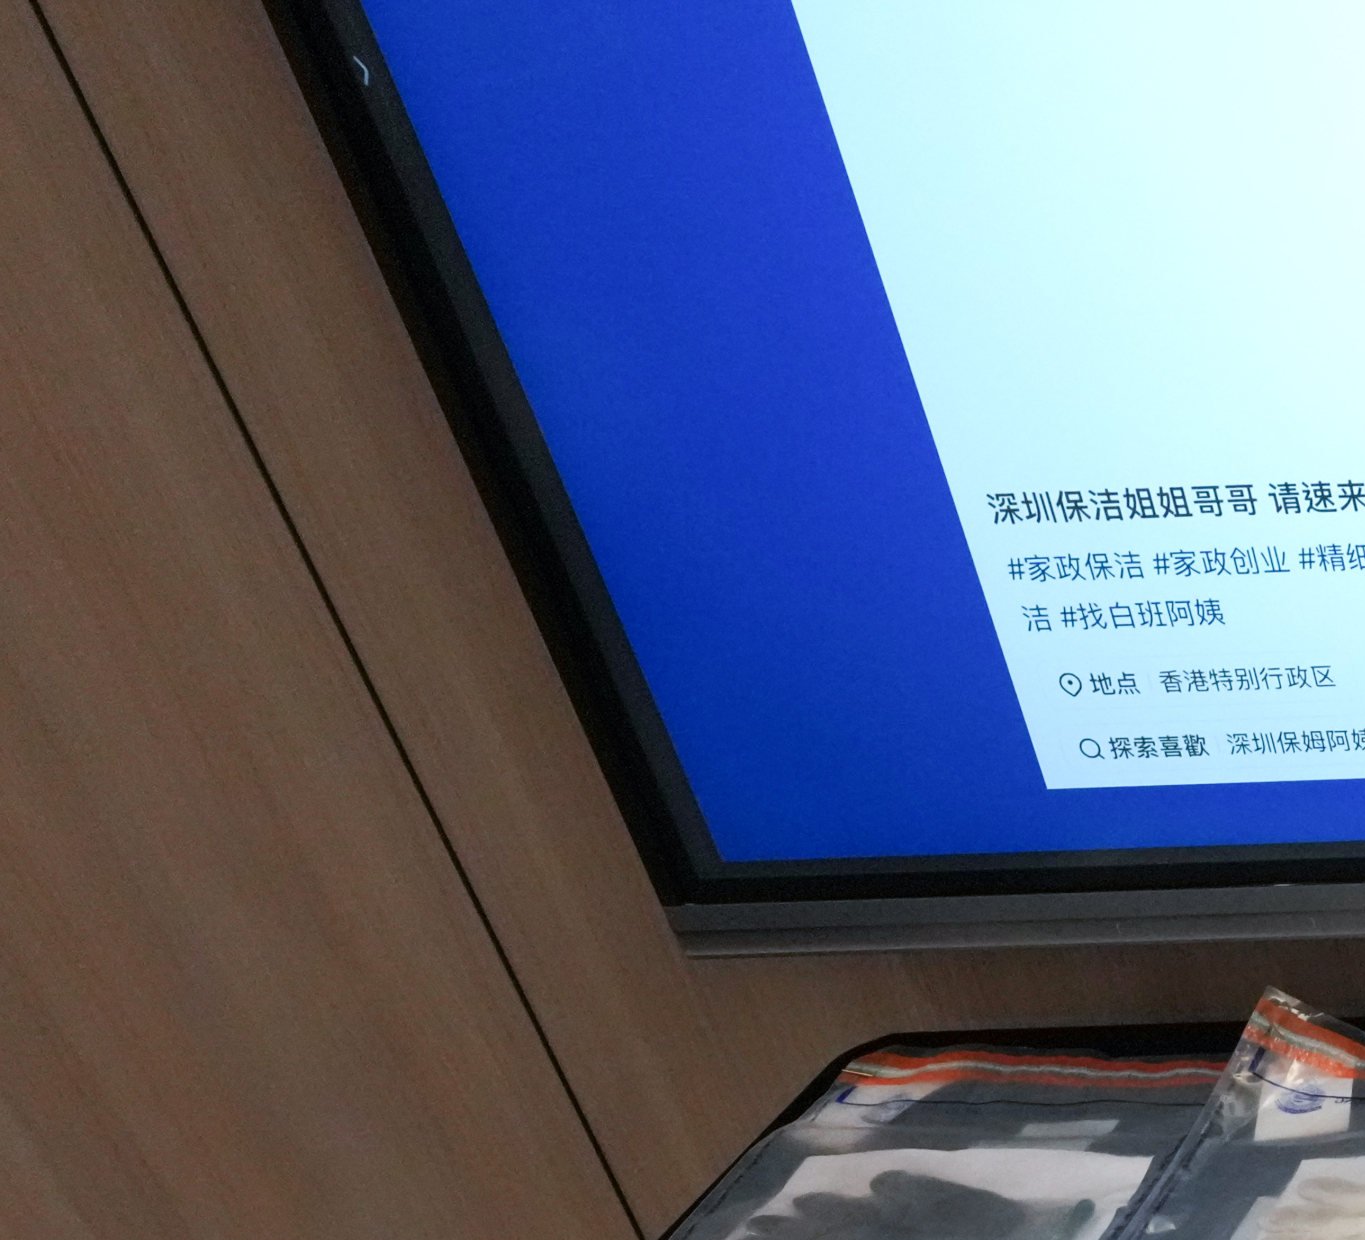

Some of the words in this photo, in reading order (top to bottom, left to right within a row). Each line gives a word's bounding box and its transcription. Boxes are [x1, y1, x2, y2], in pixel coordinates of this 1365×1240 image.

[986, 484, 1257, 525] 深圳保洁姐姐哥哥
[1008, 551, 1144, 582] #家政保洁
[1153, 546, 1290, 577] #家政创业
[1021, 604, 1052, 632] 洁
[1060, 598, 1225, 630] #找白班阿姨
[1089, 672, 1140, 695] 地点
[1159, 666, 1336, 693] 香港特别行政区
[1108, 734, 1210, 759] 探索喜歡
